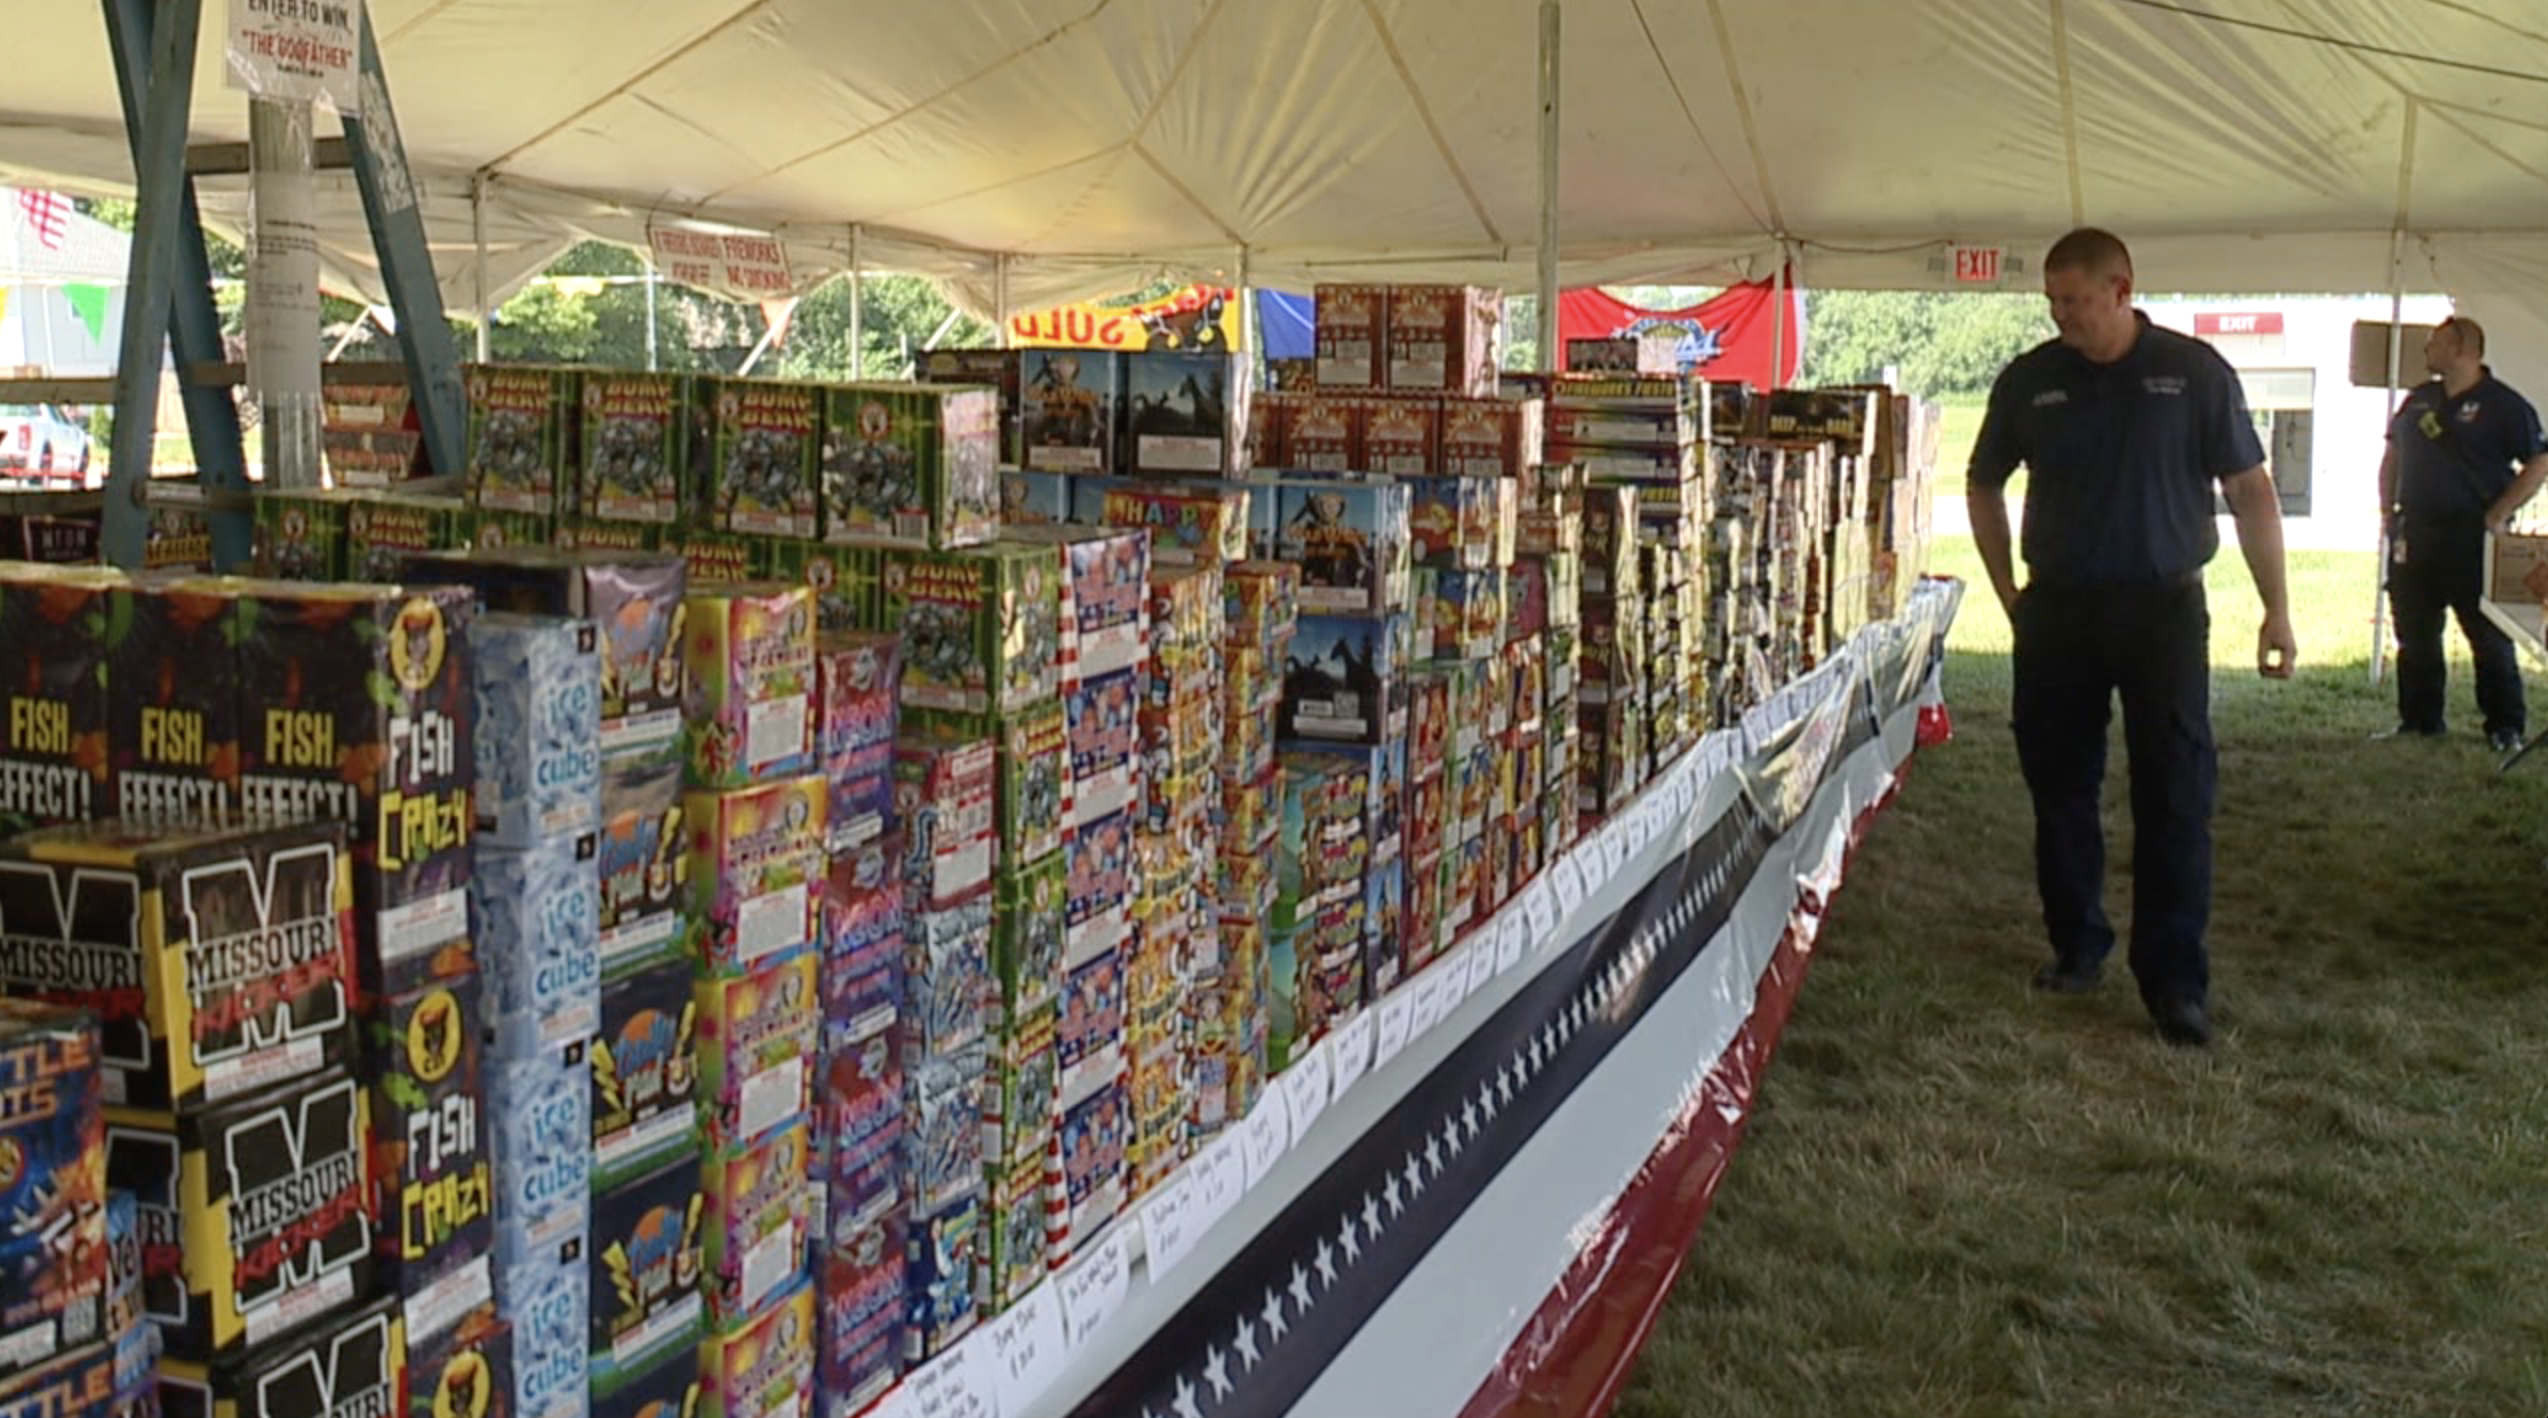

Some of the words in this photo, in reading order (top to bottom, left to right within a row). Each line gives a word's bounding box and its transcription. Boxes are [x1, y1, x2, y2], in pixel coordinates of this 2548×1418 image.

[302, 0, 319, 22] TO
[322, 3, 348, 28] WIN
[1955, 248, 1999, 278] EXIT
[2219, 315, 2257, 332] EXIT
[11, 697, 69, 754] FISH
[550, 681, 588, 722] ice
[141, 706, 203, 765] FISH
[265, 709, 334, 768] FISH
[389, 711, 455, 788] FISH
[537, 747, 596, 787] cube
[378, 789, 467, 870] CRAZY
[546, 889, 587, 937] ice
[186, 918, 336, 990] MISSOURI
[537, 949, 596, 996] cube
[407, 1093, 477, 1181] FISH
[533, 1096, 577, 1143] ice
[227, 1150, 359, 1242] MISSOURI
[524, 1154, 586, 1202] cube
[402, 1161, 490, 1261] CRAZY
[530, 1293, 572, 1340] ice
[523, 1345, 584, 1399] cube
